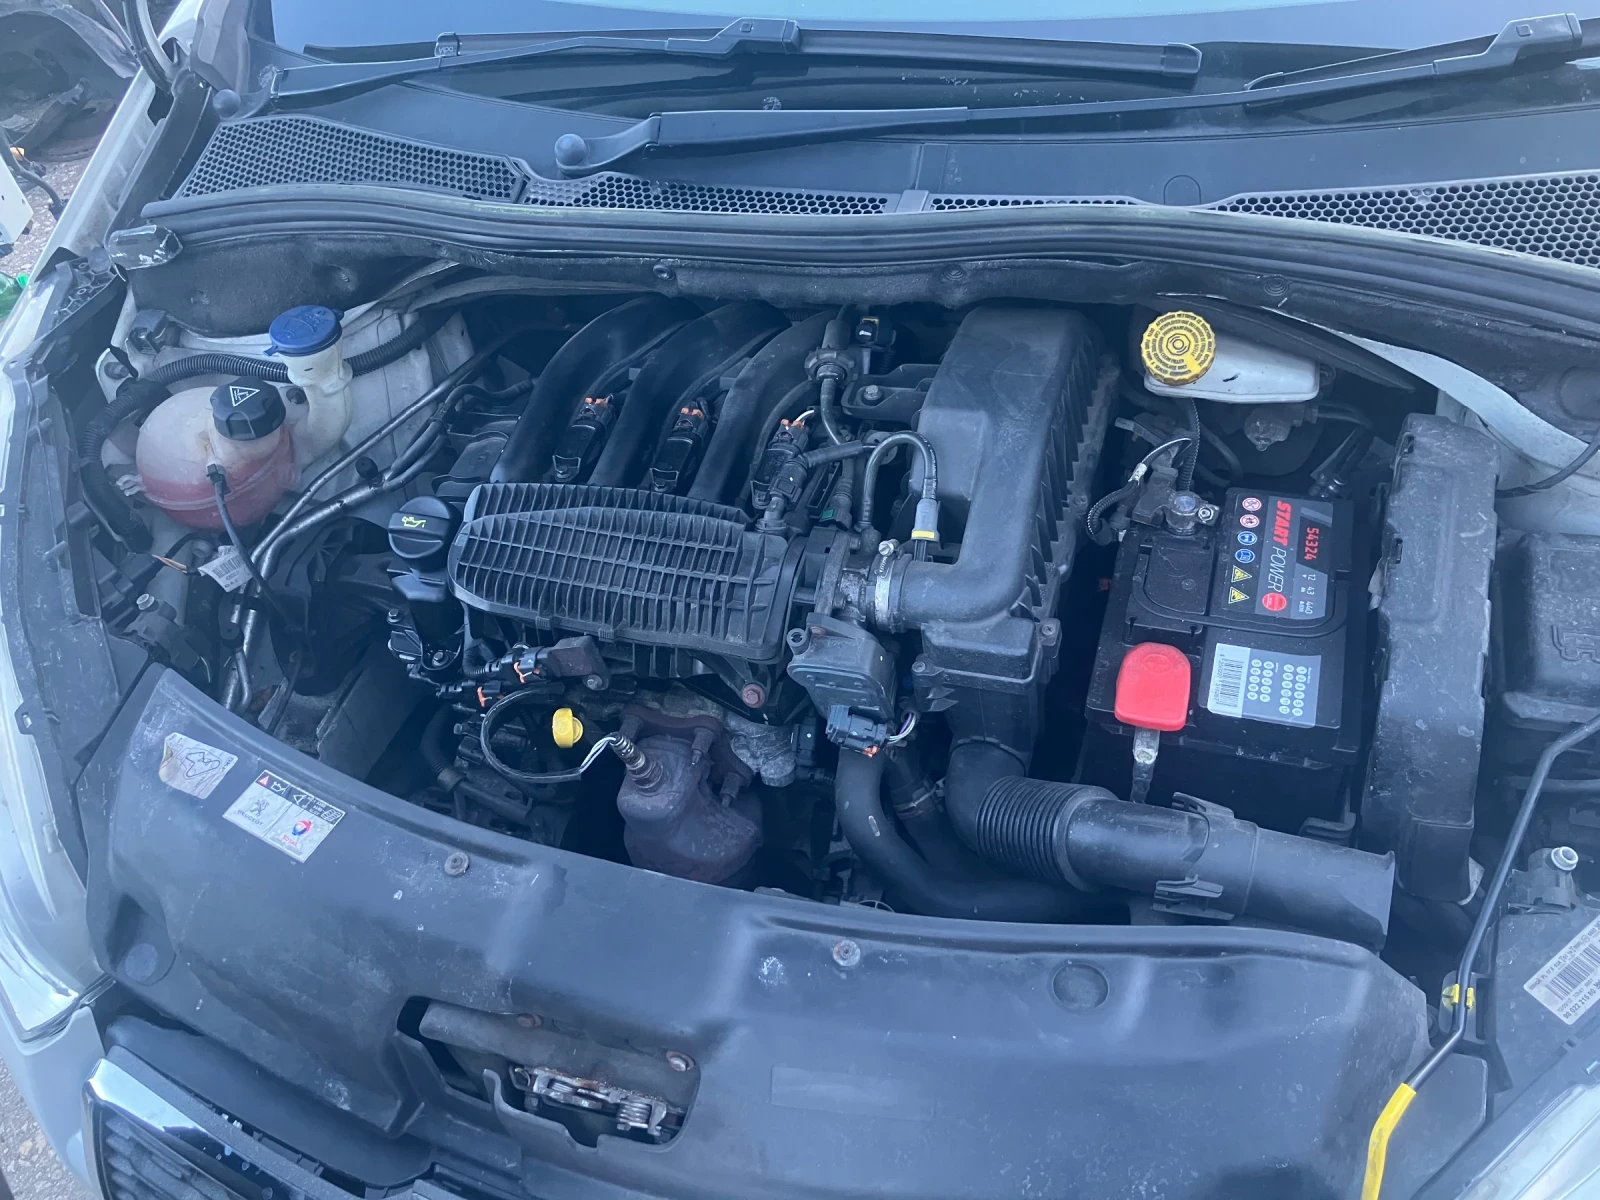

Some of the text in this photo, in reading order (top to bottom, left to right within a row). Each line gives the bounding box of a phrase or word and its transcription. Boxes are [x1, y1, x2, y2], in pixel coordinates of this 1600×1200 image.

[1273, 500, 1292, 546] START
[1304, 527, 1319, 560] 54324
[1268, 546, 1287, 592] POWER
[1307, 586, 1315, 595] 43
[1305, 601, 1314, 614] 440
[237, 810, 263, 826] PEUGEOT
[283, 834, 298, 847] TOTAL
